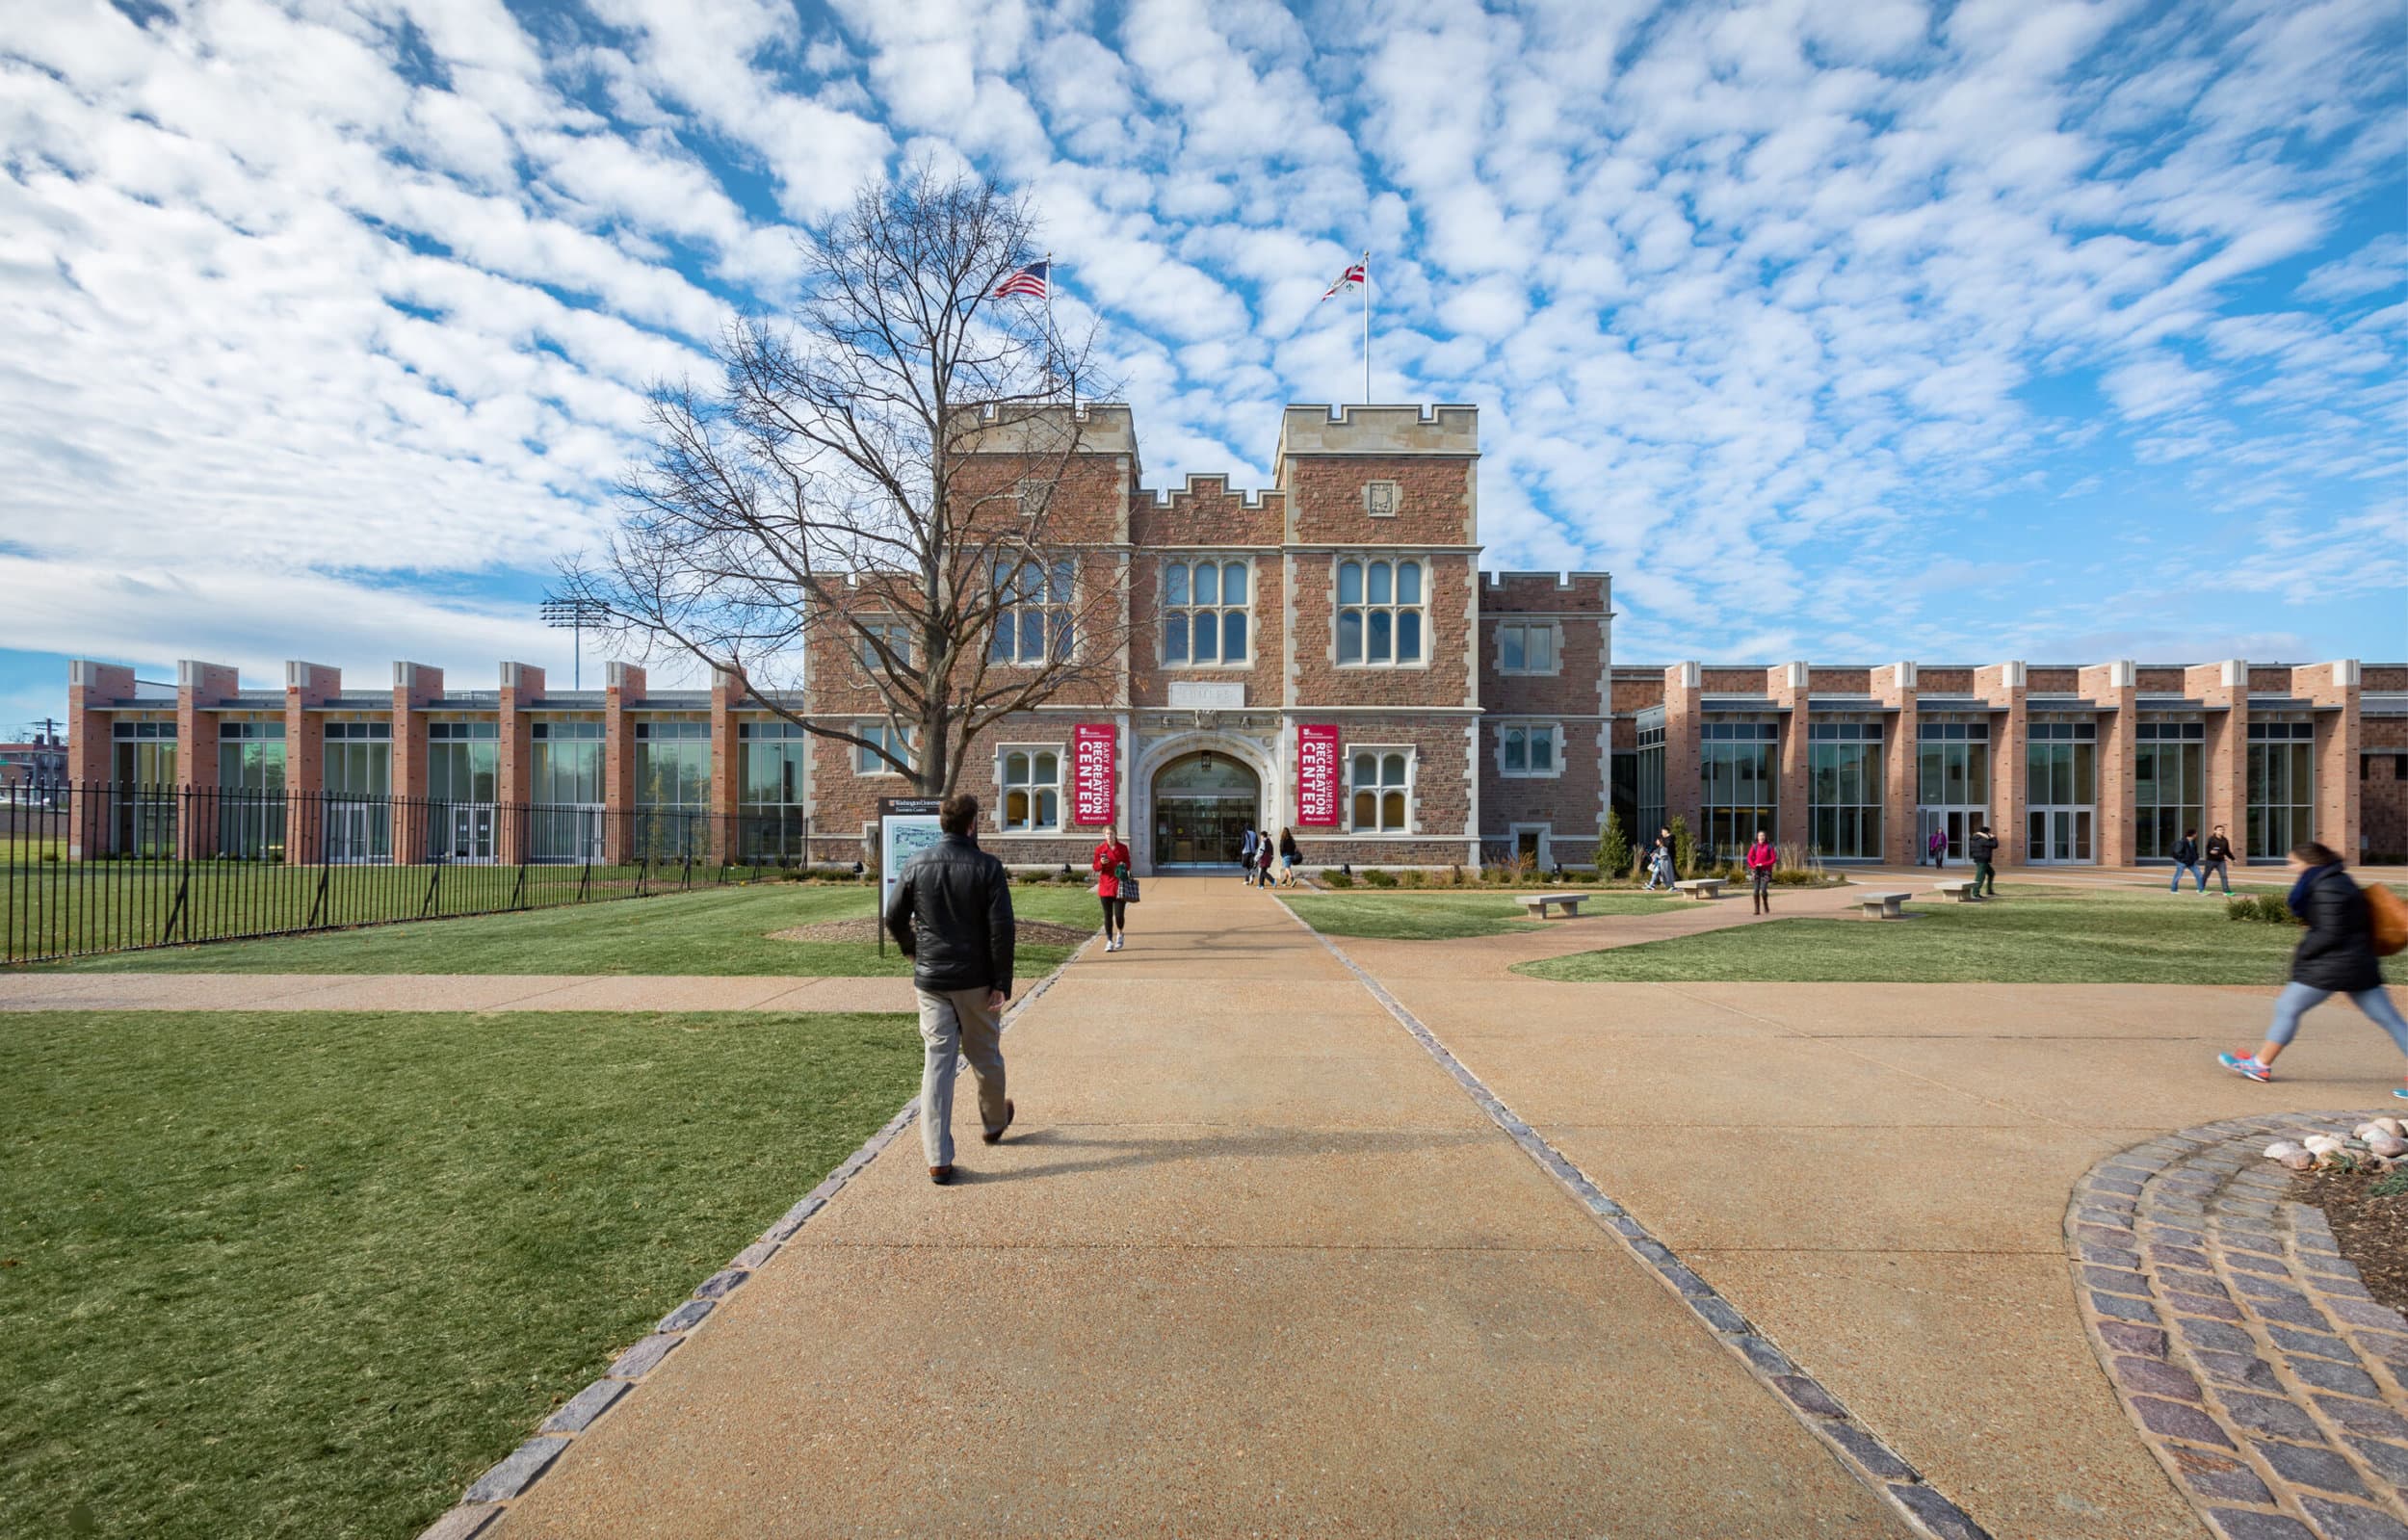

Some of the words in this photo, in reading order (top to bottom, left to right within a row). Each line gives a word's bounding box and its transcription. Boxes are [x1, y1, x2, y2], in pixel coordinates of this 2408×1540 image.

[1080, 742, 1092, 814] CENTER
[1092, 742, 1103, 814] RECREATION
[1302, 743, 1315, 815] CENTER
[1316, 743, 1325, 815] RECREATION
